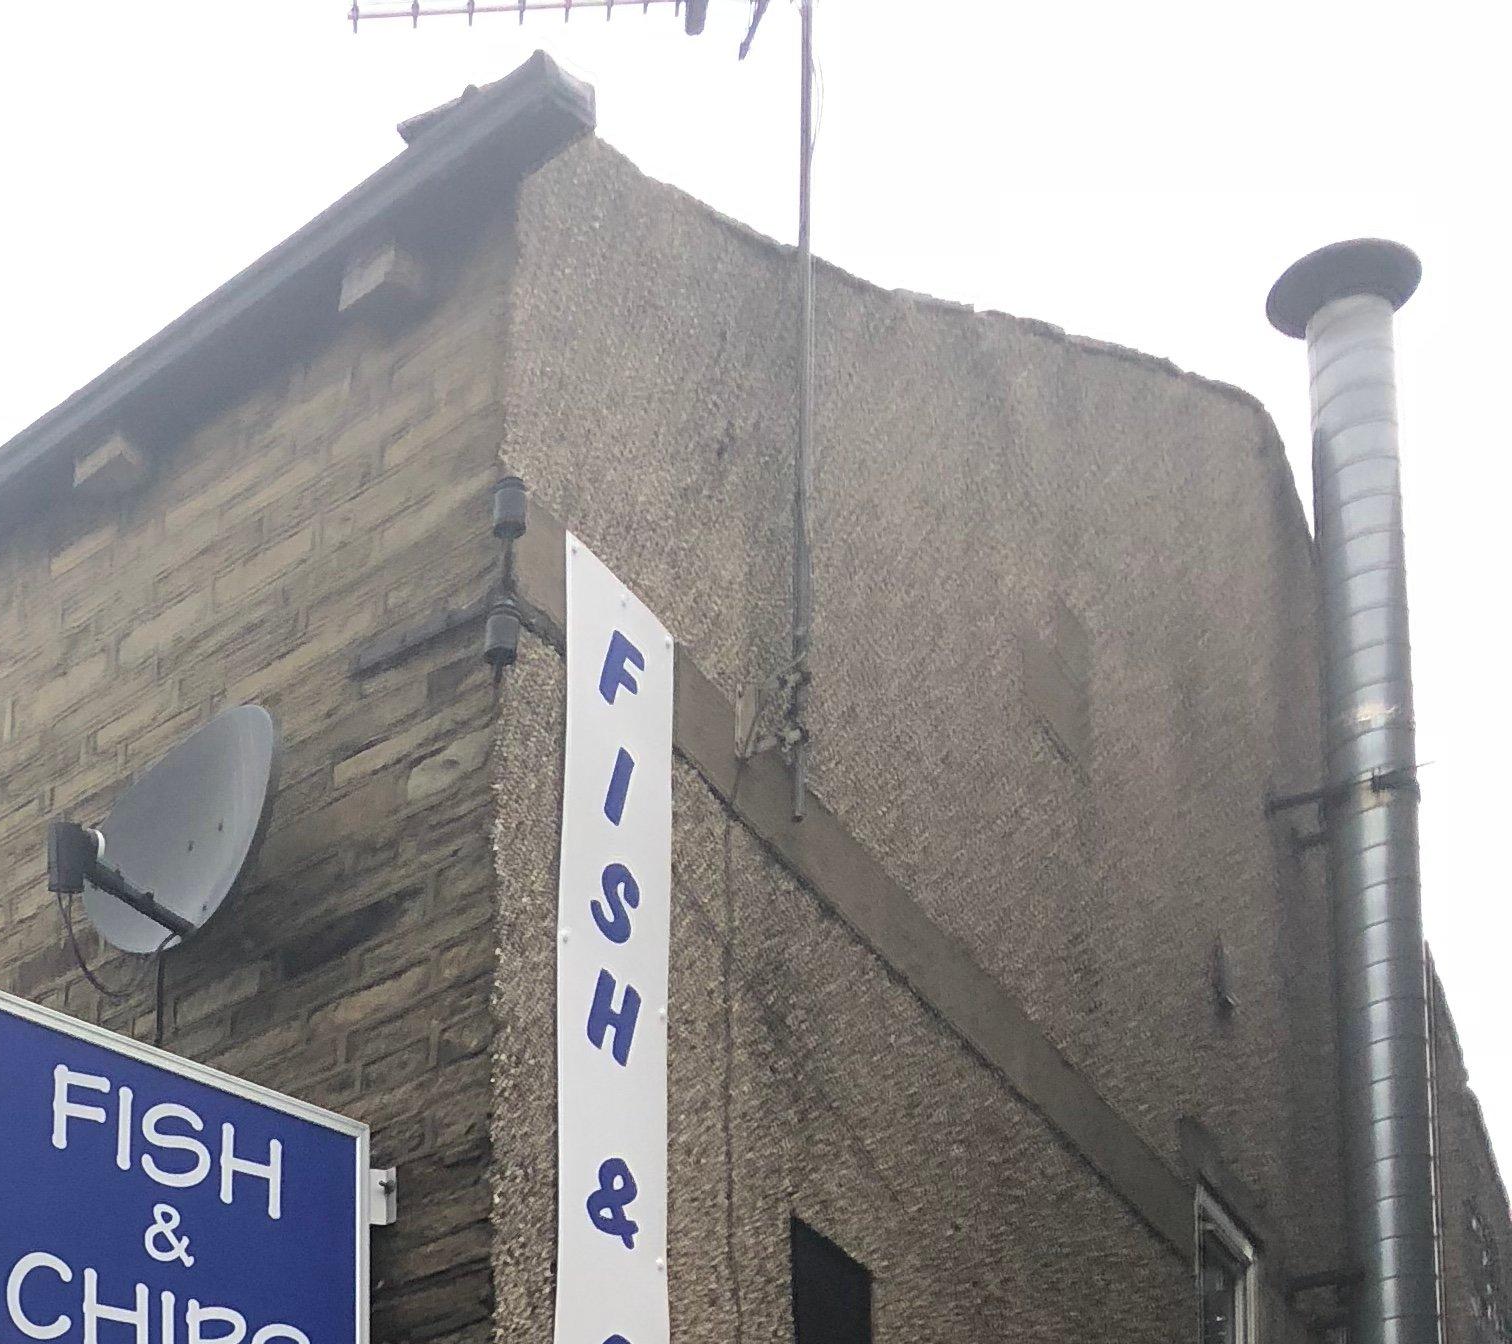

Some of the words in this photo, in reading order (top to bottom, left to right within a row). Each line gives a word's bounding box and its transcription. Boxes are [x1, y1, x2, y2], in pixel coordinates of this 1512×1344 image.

[587, 629, 645, 1068] FISH
[51, 1063, 282, 1220] FISH
[587, 1157, 639, 1250] &
[144, 1203, 194, 1267] &
